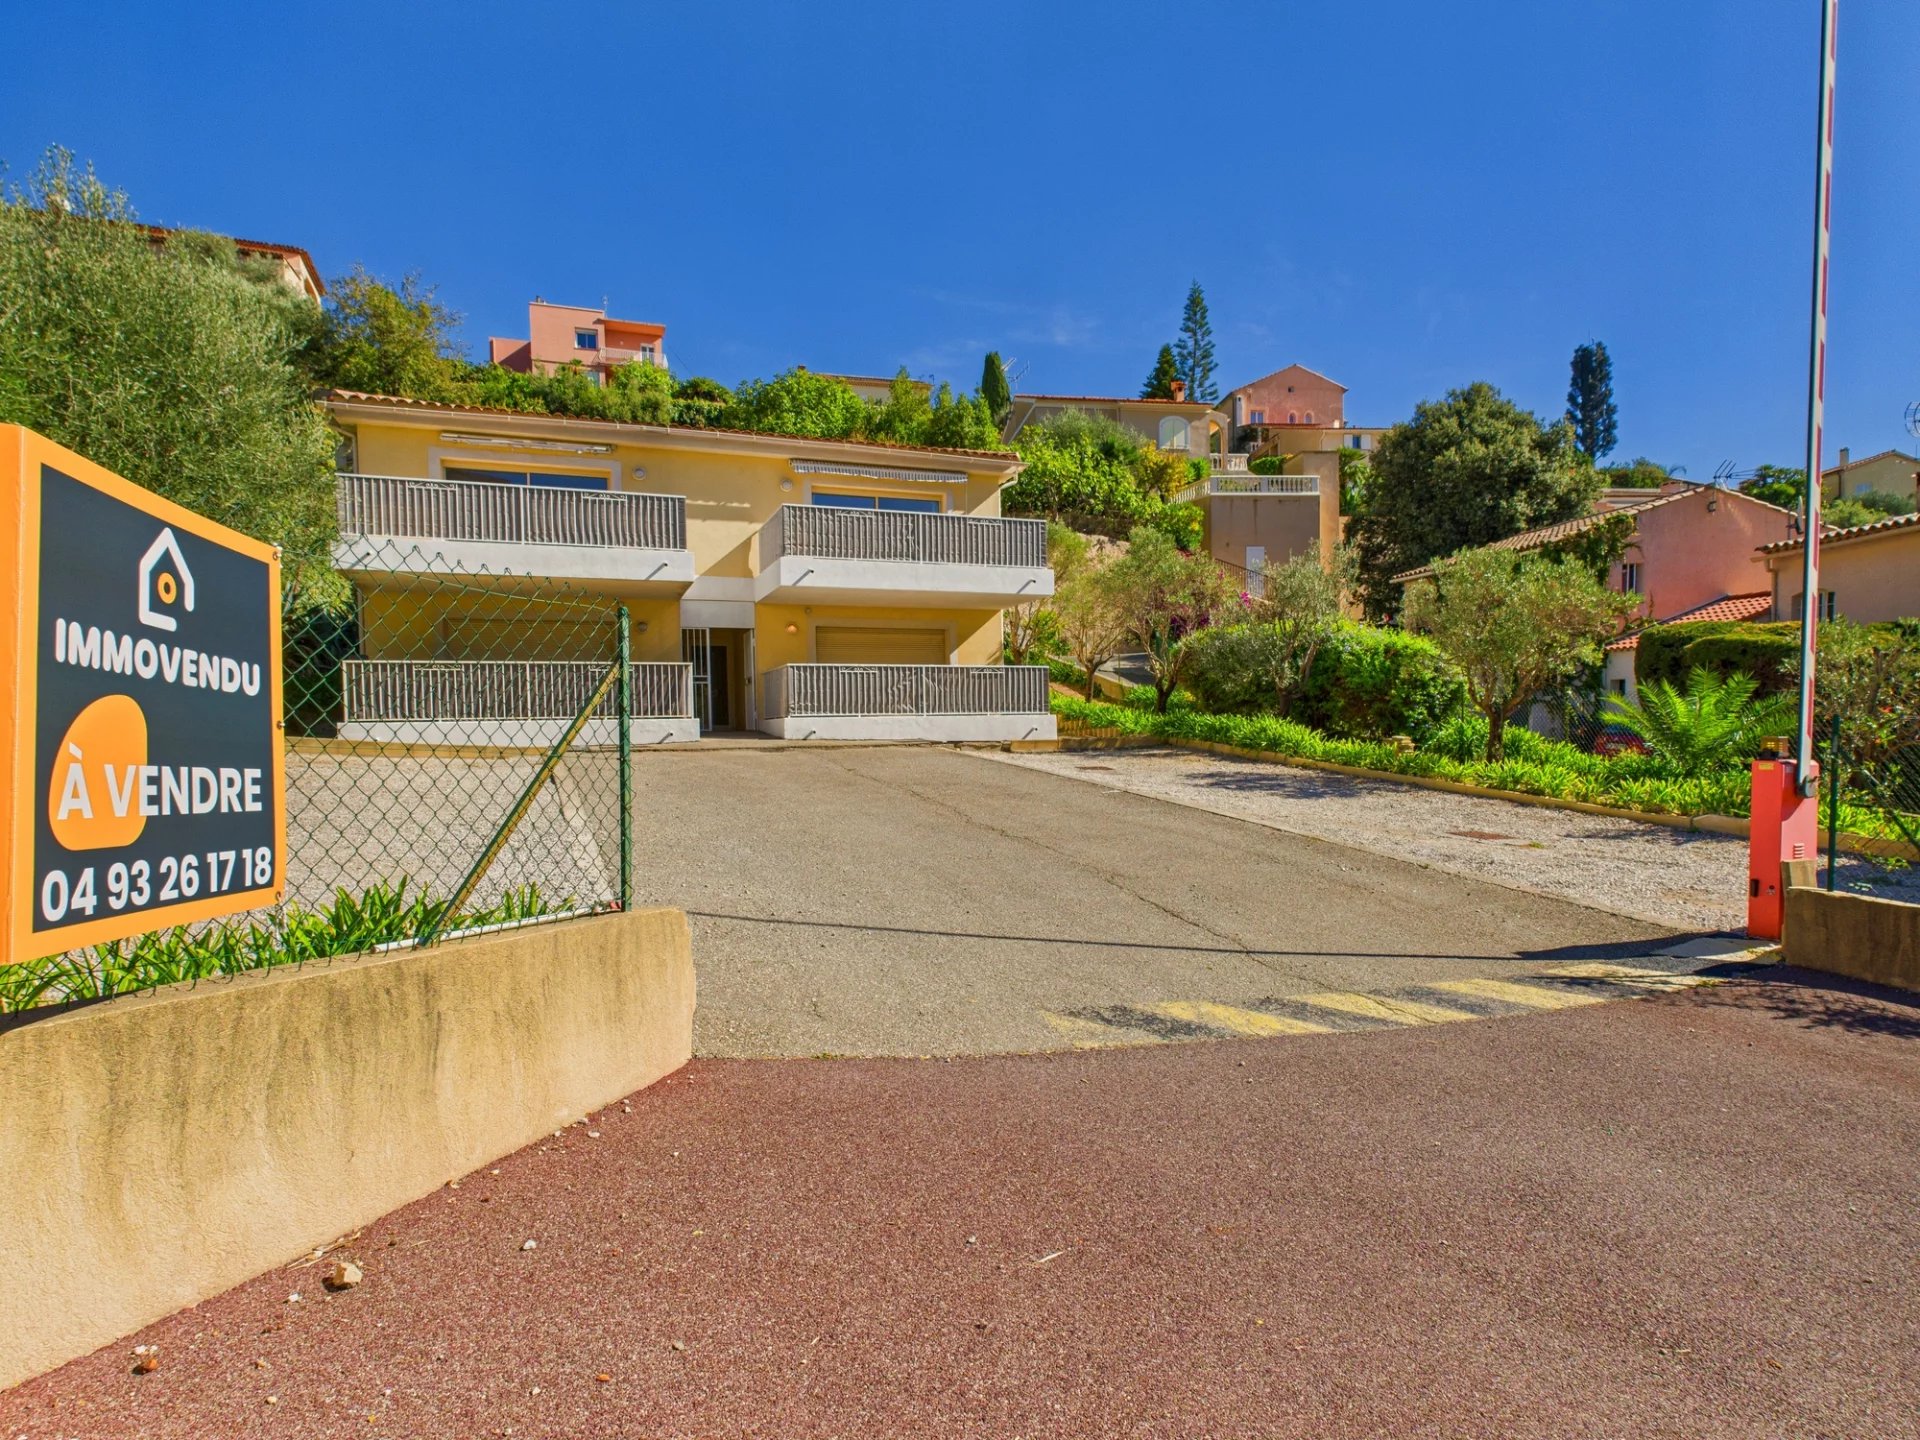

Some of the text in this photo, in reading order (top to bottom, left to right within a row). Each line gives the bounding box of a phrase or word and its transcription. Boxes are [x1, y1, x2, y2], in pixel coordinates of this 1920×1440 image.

[55, 617, 261, 697] IMMOVENDU
[57, 742, 263, 820] À VENDRE
[41, 846, 273, 922] 04 93 26 17 18
